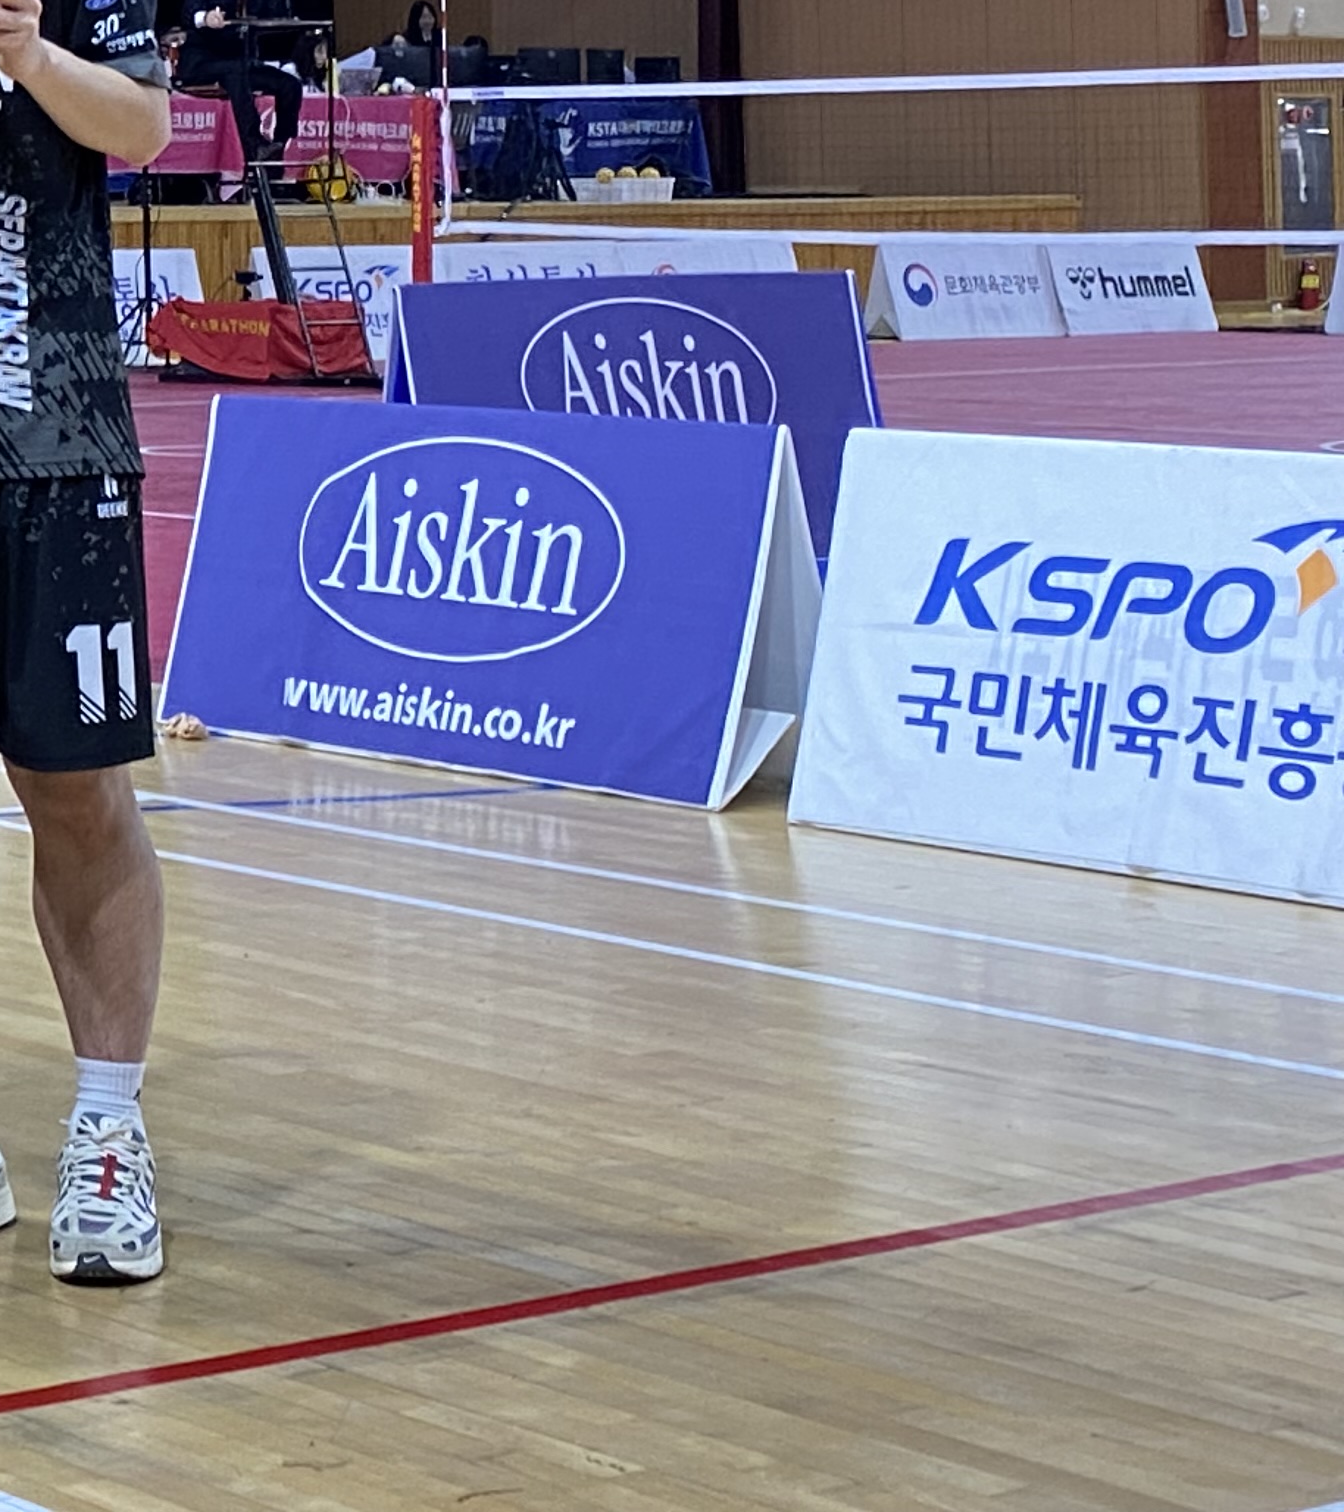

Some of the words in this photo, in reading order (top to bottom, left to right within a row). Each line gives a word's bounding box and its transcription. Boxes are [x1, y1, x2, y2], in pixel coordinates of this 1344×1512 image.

[944, 274, 1041, 297] 문화체육관광부
[1097, 265, 1196, 299] hummel
[561, 330, 750, 424] Aiskin
[320, 472, 585, 616] Aiskin
[914, 538, 1276, 654] KSPO
[65, 620, 138, 725] 11
[282, 675, 576, 751] www.aiskin.co.kr
[898, 663, 1344, 801] 국민체육진흥
